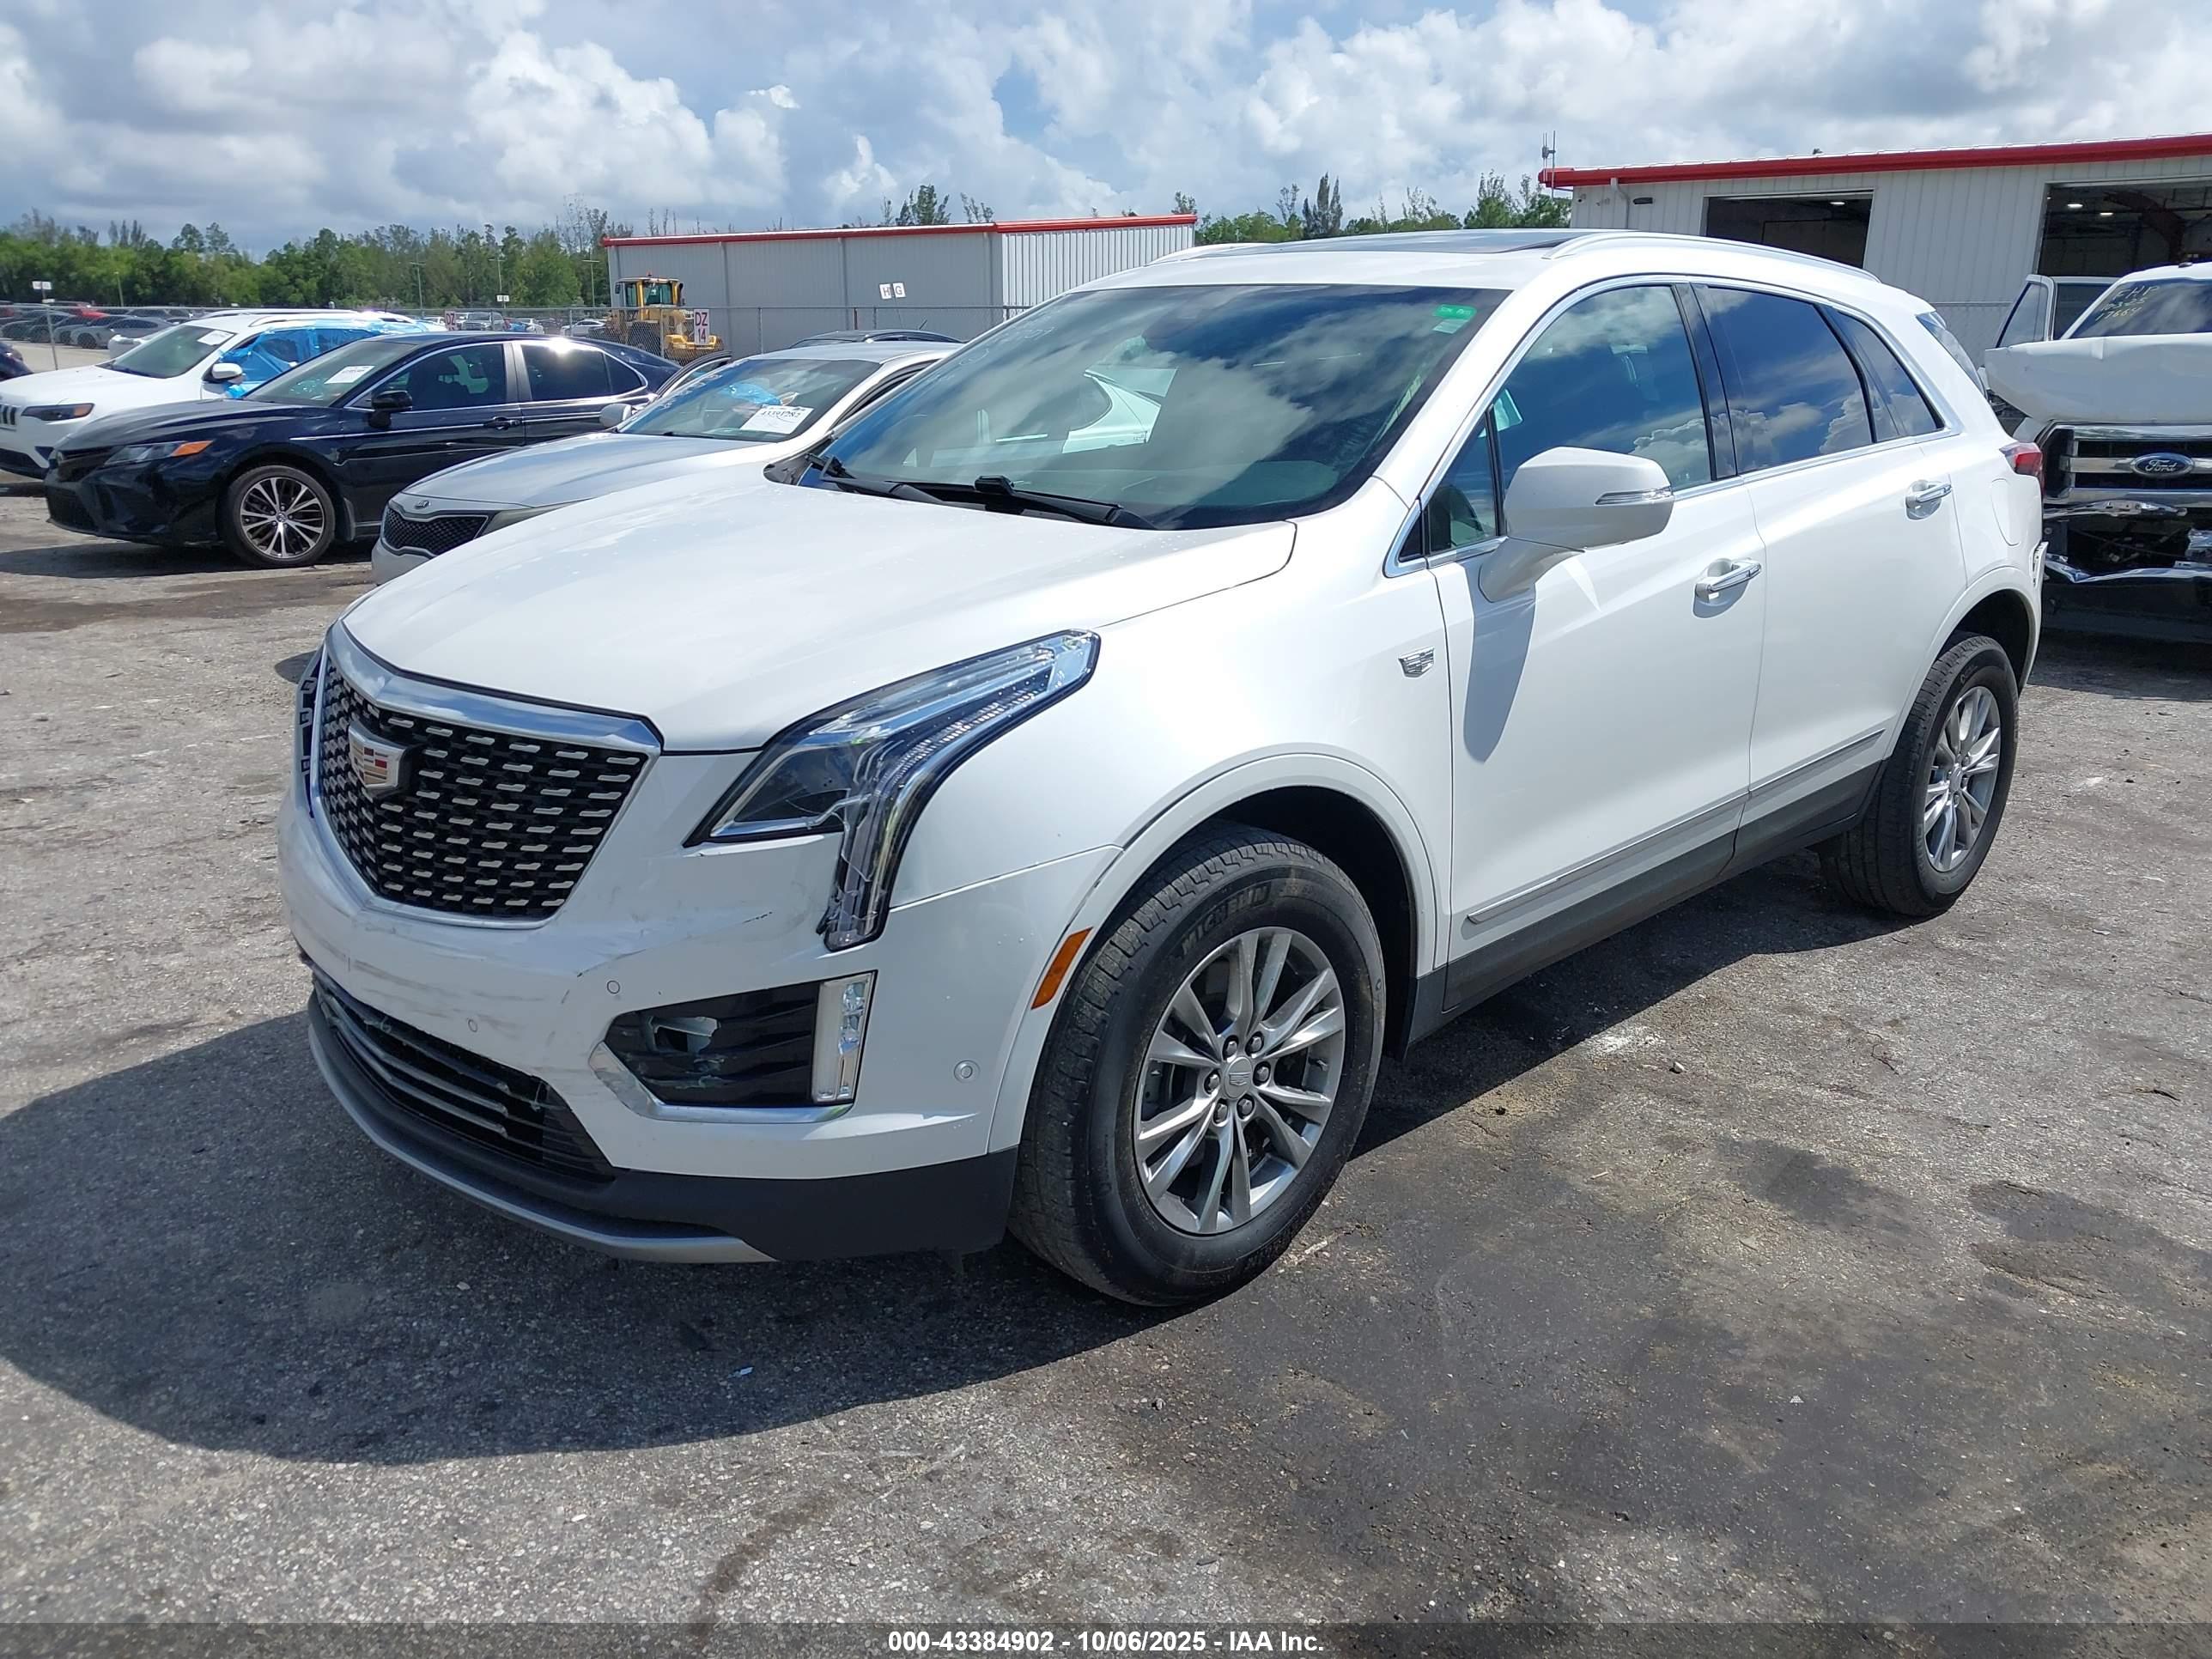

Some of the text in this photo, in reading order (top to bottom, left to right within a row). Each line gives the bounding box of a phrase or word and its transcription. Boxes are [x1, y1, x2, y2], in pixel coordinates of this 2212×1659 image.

[446, 313, 456, 325] DZ
[695, 312, 708, 326] DZ
[697, 328, 707, 343] 14
[2145, 459, 2178, 472] Ford
[1181, 884, 1271, 955] MICHELIN
